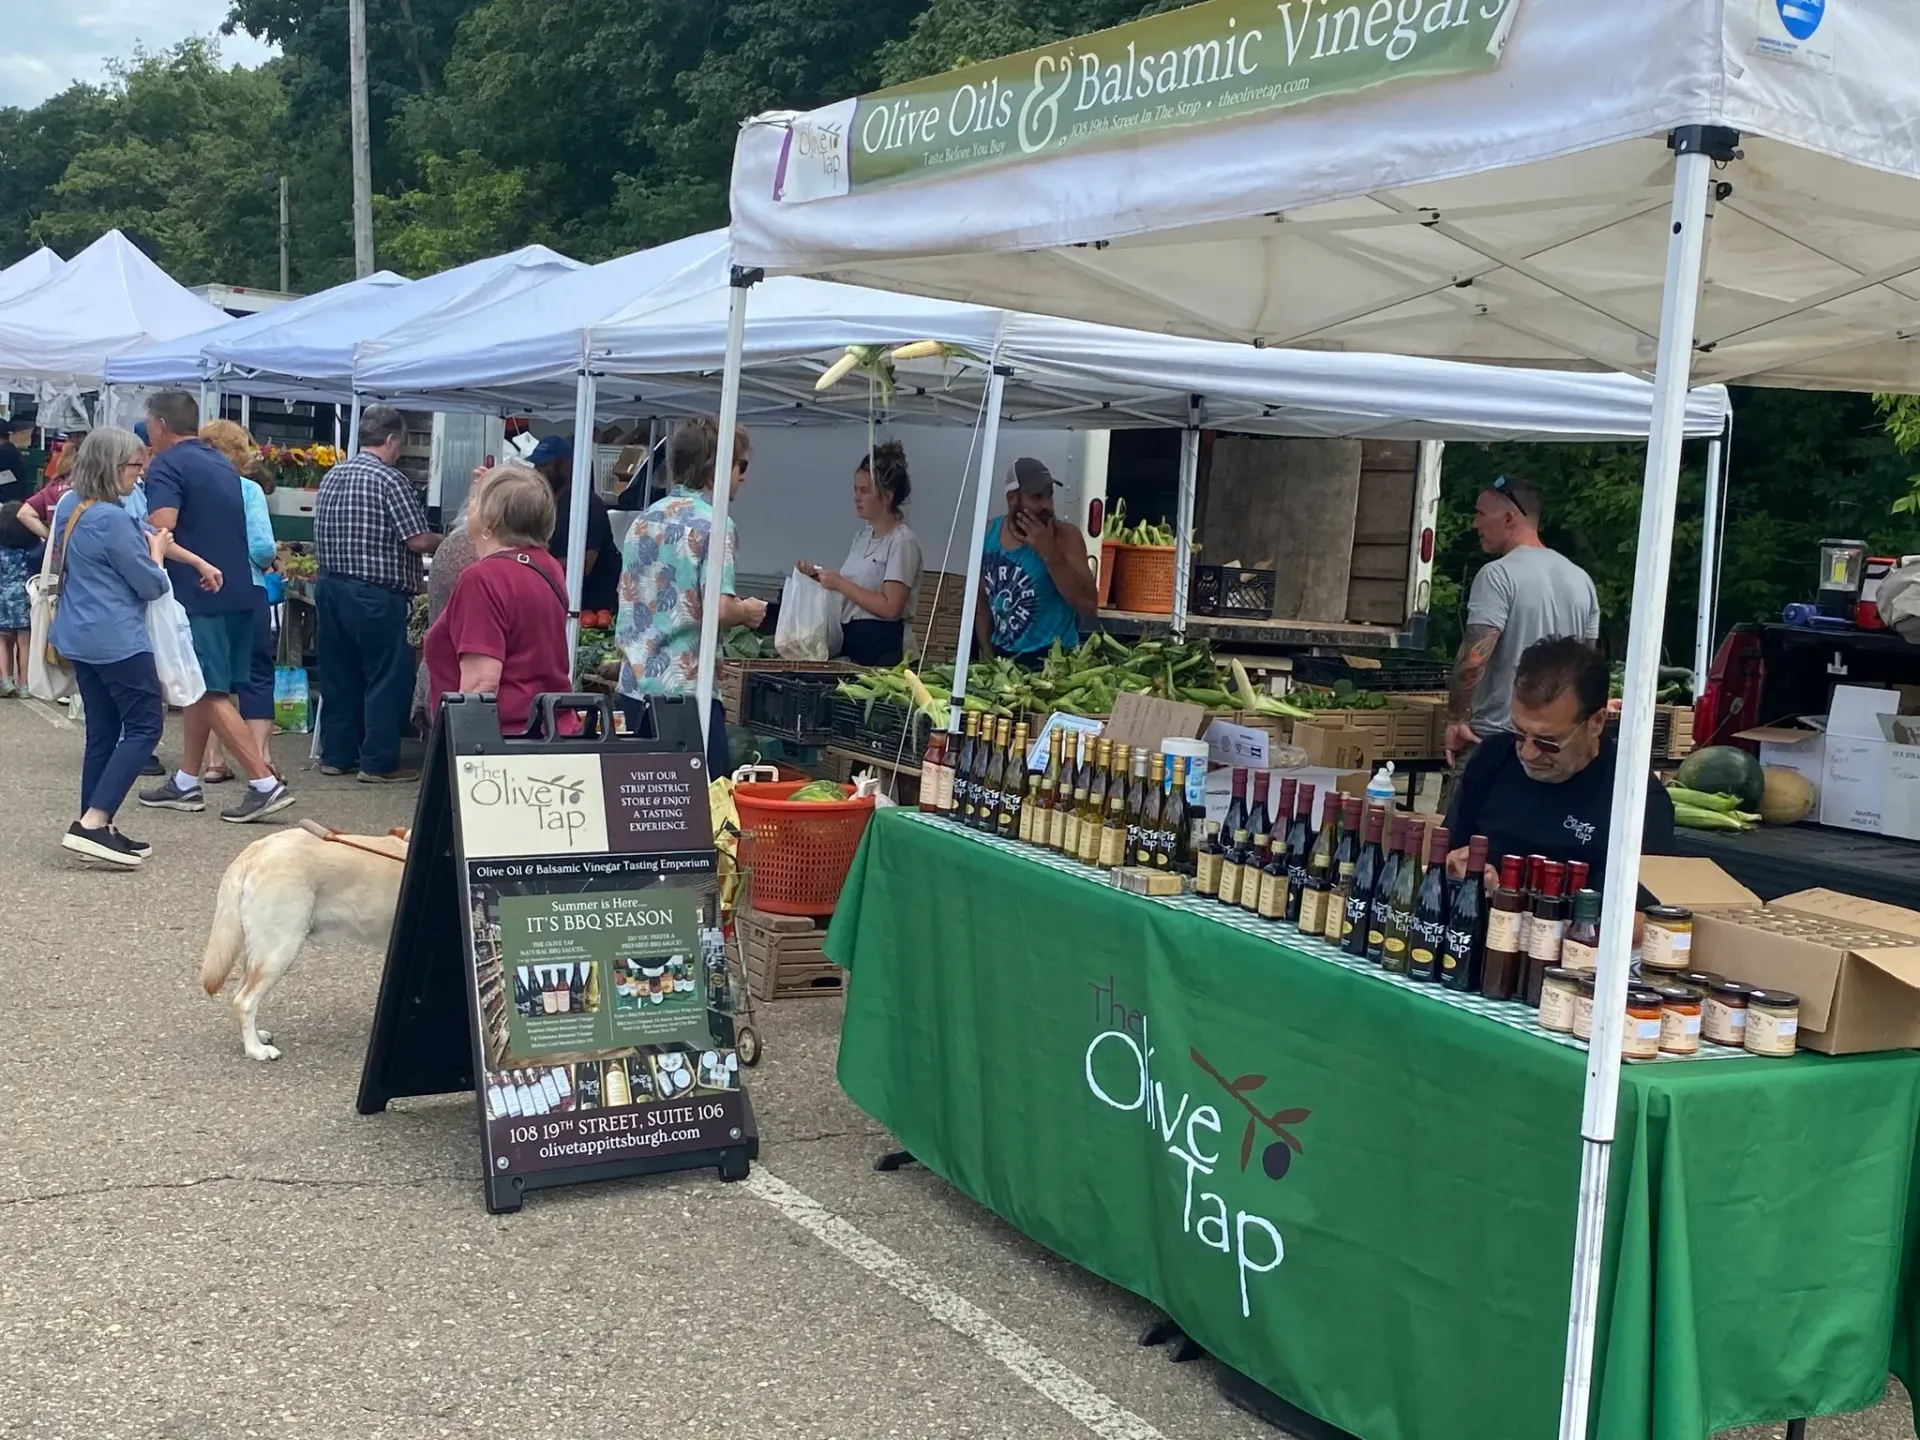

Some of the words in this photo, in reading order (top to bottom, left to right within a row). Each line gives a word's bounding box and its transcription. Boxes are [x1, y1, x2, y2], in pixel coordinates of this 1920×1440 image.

[863, 100, 940, 154] Olive
[948, 76, 1014, 137] Oils
[1017, 47, 1076, 154] &
[1073, 18, 1263, 113] Balsamic
[1071, 122, 1088, 138] 108
[1088, 119, 1110, 136] 19th
[1110, 113, 1139, 131] Street
[1140, 109, 1152, 124] In
[1153, 104, 1174, 121] The
[1175, 99, 1202, 118] Strip
[1218, 76, 1310, 108] theolivetap.com
[923, 151, 944, 167] Taste
[945, 144, 971, 162] Before
[972, 142, 989, 157] You
[989, 139, 1007, 157] Buy
[819, 149, 841, 190] Tap
[473, 760, 502, 780] The
[630, 771, 655, 781] VISIT
[656, 771, 678, 781] OUR
[470, 768, 552, 807] Olive
[620, 784, 646, 794] STRIP
[647, 783, 690, 793] DISTRICT
[621, 797, 652, 807] STORE
[653, 796, 661, 806] &
[662, 795, 692, 807] ENJOY
[633, 810, 641, 819] A
[641, 808, 683, 819] TASTING
[528, 803, 586, 847] Tap
[629, 820, 688, 832] EXPERIENCE.
[1574, 828, 1592, 846] Tap
[476, 866, 505, 878] Olive
[506, 865, 523, 877] Oil
[524, 865, 534, 876] &
[536, 863, 581, 876] Balsamic
[583, 861, 621, 874] Vinegar
[622, 860, 659, 872] Tasting
[660, 857, 710, 870] Emporium
[551, 900, 598, 912] Summer
[601, 898, 611, 909] is
[612, 897, 648, 909] Here...
[526, 916, 560, 933] IT'S
[563, 913, 603, 931] BBQ
[604, 908, 674, 928] SEASON
[1424, 931, 1444, 949] Tap
[1087, 974, 1143, 1036] The
[1085, 1015, 1222, 1164] Olive
[510, 1124, 539, 1144] 108
[542, 1119, 574, 1140] 19TH
[578, 1112, 644, 1136] STREET,
[646, 1106, 694, 1127] SUITE
[696, 1102, 725, 1122] 106
[539, 1127, 701, 1158] olivetappittsburgh.com
[1168, 1145, 1285, 1318] Tap
